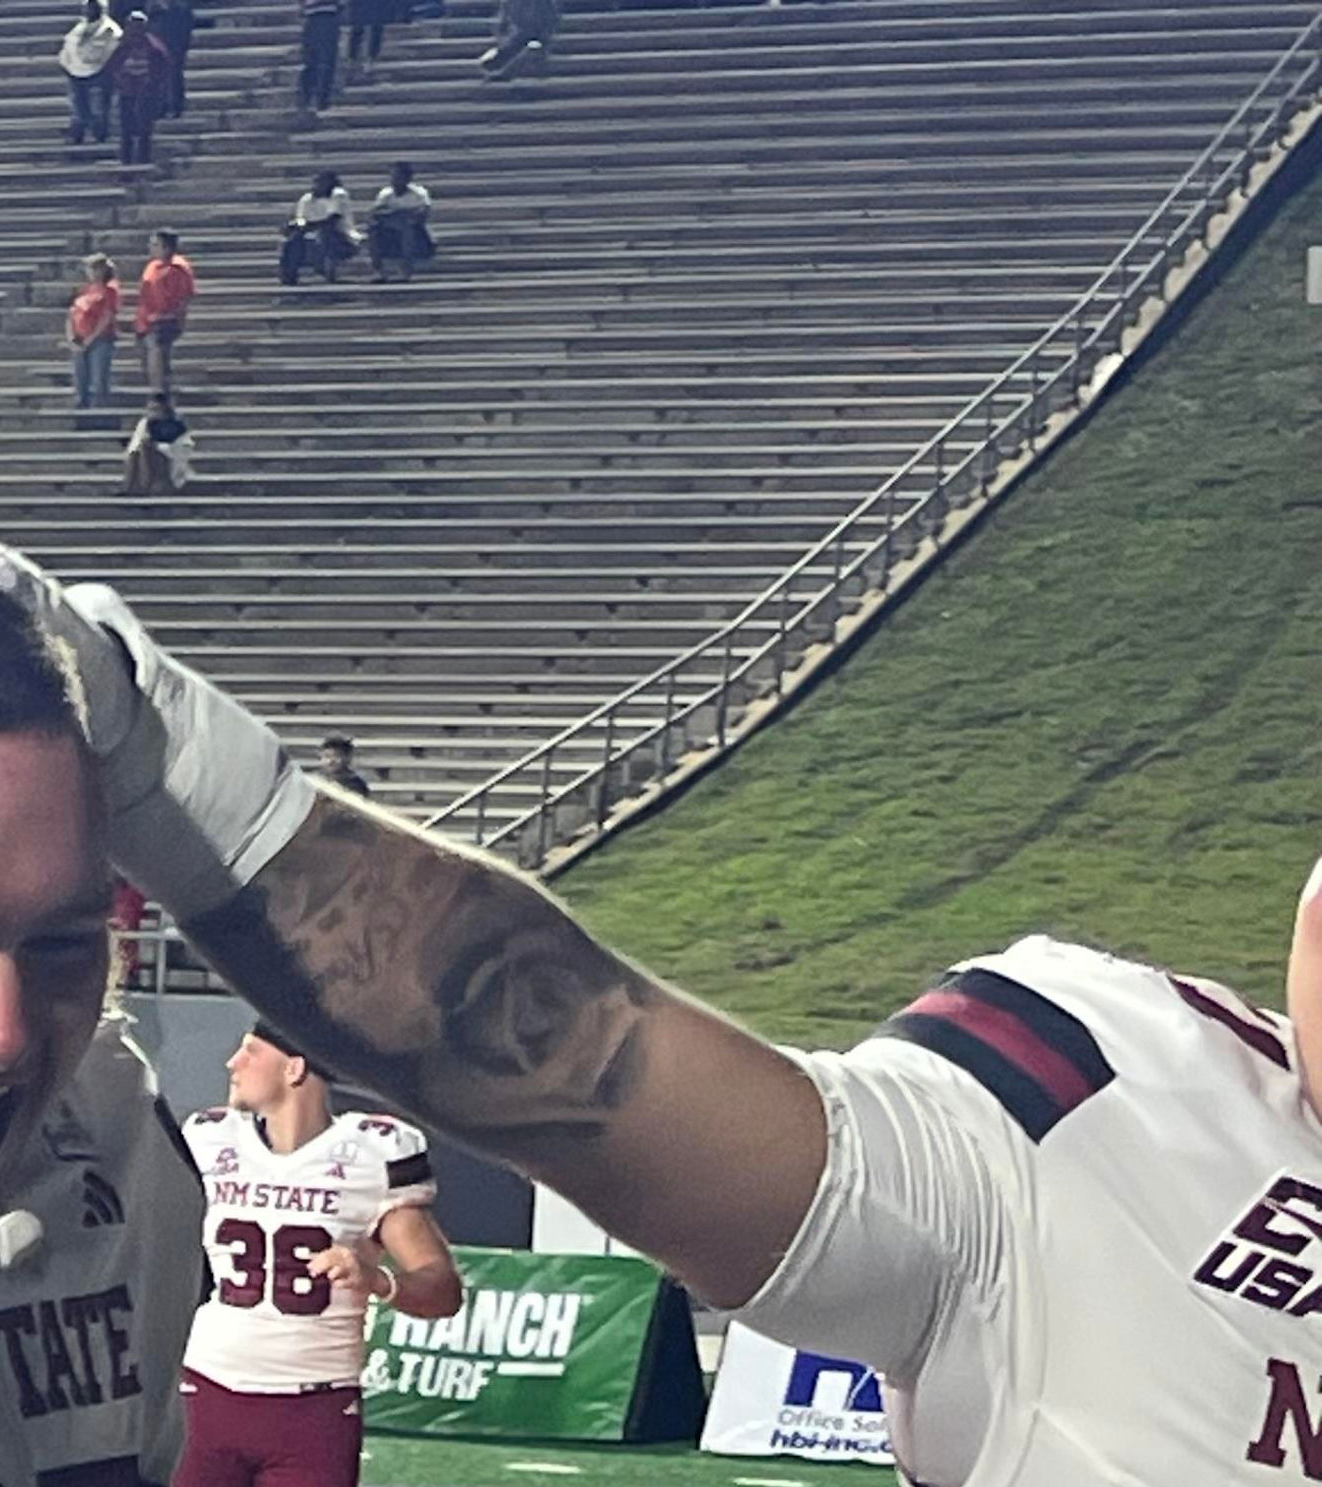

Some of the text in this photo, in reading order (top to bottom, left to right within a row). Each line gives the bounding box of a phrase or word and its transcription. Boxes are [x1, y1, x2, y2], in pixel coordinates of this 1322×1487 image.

[213, 1181, 342, 1215] NM STATE
[397, 1352, 495, 1401] TURF
[777, 1408, 845, 1431] Office
